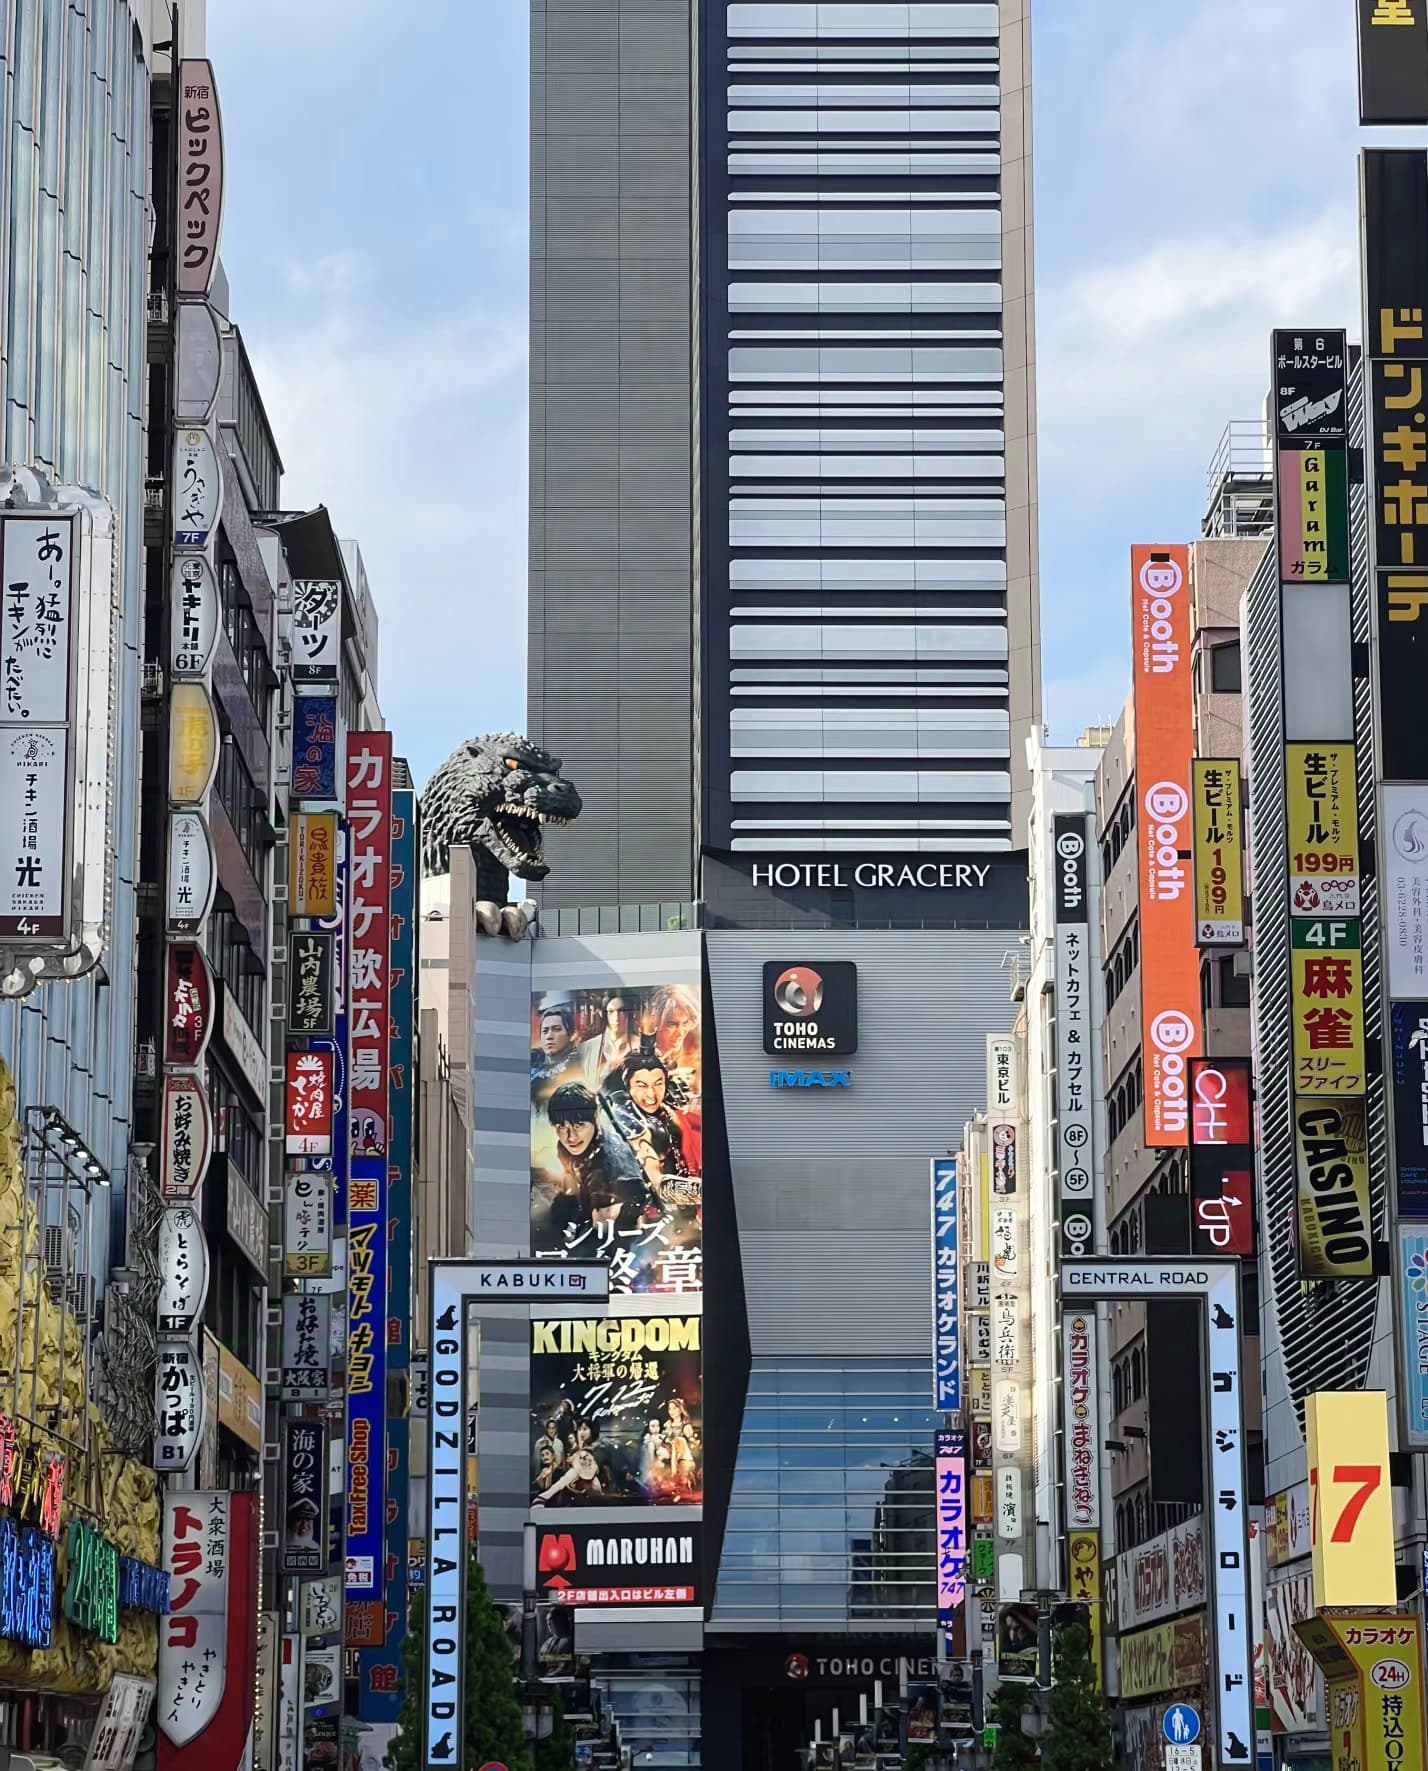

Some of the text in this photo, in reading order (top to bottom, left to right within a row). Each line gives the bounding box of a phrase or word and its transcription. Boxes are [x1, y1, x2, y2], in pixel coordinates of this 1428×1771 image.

[184, 85, 210, 99] 新宿
[1315, 338, 1325, 351] 6
[1280, 387, 1296, 396] 8F
[1304, 441, 1321, 450] 7F
[1304, 457, 1326, 552] Garam
[182, 532, 200, 544] 7F
[1290, 560, 1340, 576] ガラム
[302, 585, 334, 659] ダーツ
[1139, 559, 1183, 673] Booth
[175, 653, 204, 670] 6F
[308, 665, 321, 675] 8F
[22, 773, 39, 850] チキン酒場
[1203, 769, 1225, 844] 生ビール
[1303, 753, 1330, 844] 生ビール
[1330, 753, 1341, 844] ザ・プレミアム・モルツ
[1145, 781, 1188, 900] Booth
[15, 856, 43, 887] 光
[752, 863, 991, 888] HOTEL GRACERY
[1057, 832, 1085, 908] Booth
[1293, 852, 1354, 873] 199円
[177, 887, 193, 904] 光
[1211, 848, 1227, 915] 199円
[16, 917, 41, 936] 4F
[177, 919, 190, 929] 4F
[347, 748, 384, 1091] カラオケ歌広場
[1306, 922, 1347, 947] 4F
[295, 937, 324, 1019] 山内農場
[1302, 956, 1355, 1050] 麻雀
[303, 1019, 317, 1029] 5F
[773, 1022, 818, 1036] TOHO
[1065, 932, 1083, 1112] ネットカフェ & カプセル
[773, 1037, 836, 1049] CINEMAS
[769, 1070, 850, 1088] IMAX
[996, 1053, 1011, 1105] 東京ビル
[1151, 1010, 1194, 1132] Booth
[1300, 1057, 1347, 1072] スリー
[1299, 1073, 1361, 1090] ファイブ
[173, 1094, 194, 1184] お好み焼き
[298, 1136, 319, 1154] 4F
[165, 1184, 191, 1196] 2階
[350, 1183, 377, 1208] 薬
[1297, 1107, 1371, 1267] CASINO
[562, 1214, 671, 1251] シリーズ
[297, 1255, 320, 1271] 3F
[935, 1169, 960, 1402] 747 カラオケランド
[1070, 1272, 1208, 1285] CENTRAL ROAD
[166, 1317, 187, 1329] 1F
[348, 1224, 378, 1394] マツモトキヨシ
[532, 1318, 701, 1354] KINGDOM
[162, 1352, 189, 1365] 新宿
[588, 1350, 643, 1362] キングダム
[285, 1369, 327, 1387] 大阪家
[571, 1361, 660, 1382] 大将軍の帰還
[161, 1366, 189, 1437] かっぱ
[938, 1434, 964, 1443] カラオケ
[1071, 1333, 1096, 1526] カラオケ まねきねこ
[162, 1445, 184, 1460] B1
[292, 1429, 315, 1494] 海の家
[349, 1417, 371, 1537] Tax Free Shop
[1330, 1464, 1382, 1543] 7
[204, 1497, 227, 1578] 大衆酒場
[431, 1338, 460, 1720] GODZILLA ROAD
[939, 1470, 965, 1579] カラオケ
[1212, 1370, 1244, 1692] ゴジラロード
[586, 1536, 694, 1566] MARUHAN
[168, 1506, 204, 1649] トラノコ
[940, 1581, 966, 1595] 747
[1104, 1567, 1116, 1625] 3F
[1345, 1627, 1416, 1646] カラオケ
[191, 1648, 217, 1709] やきとり
[816, 1657, 875, 1676] TOHO
[1378, 1665, 1405, 1683] 24H
[1381, 1694, 1405, 1771] 持込OK
